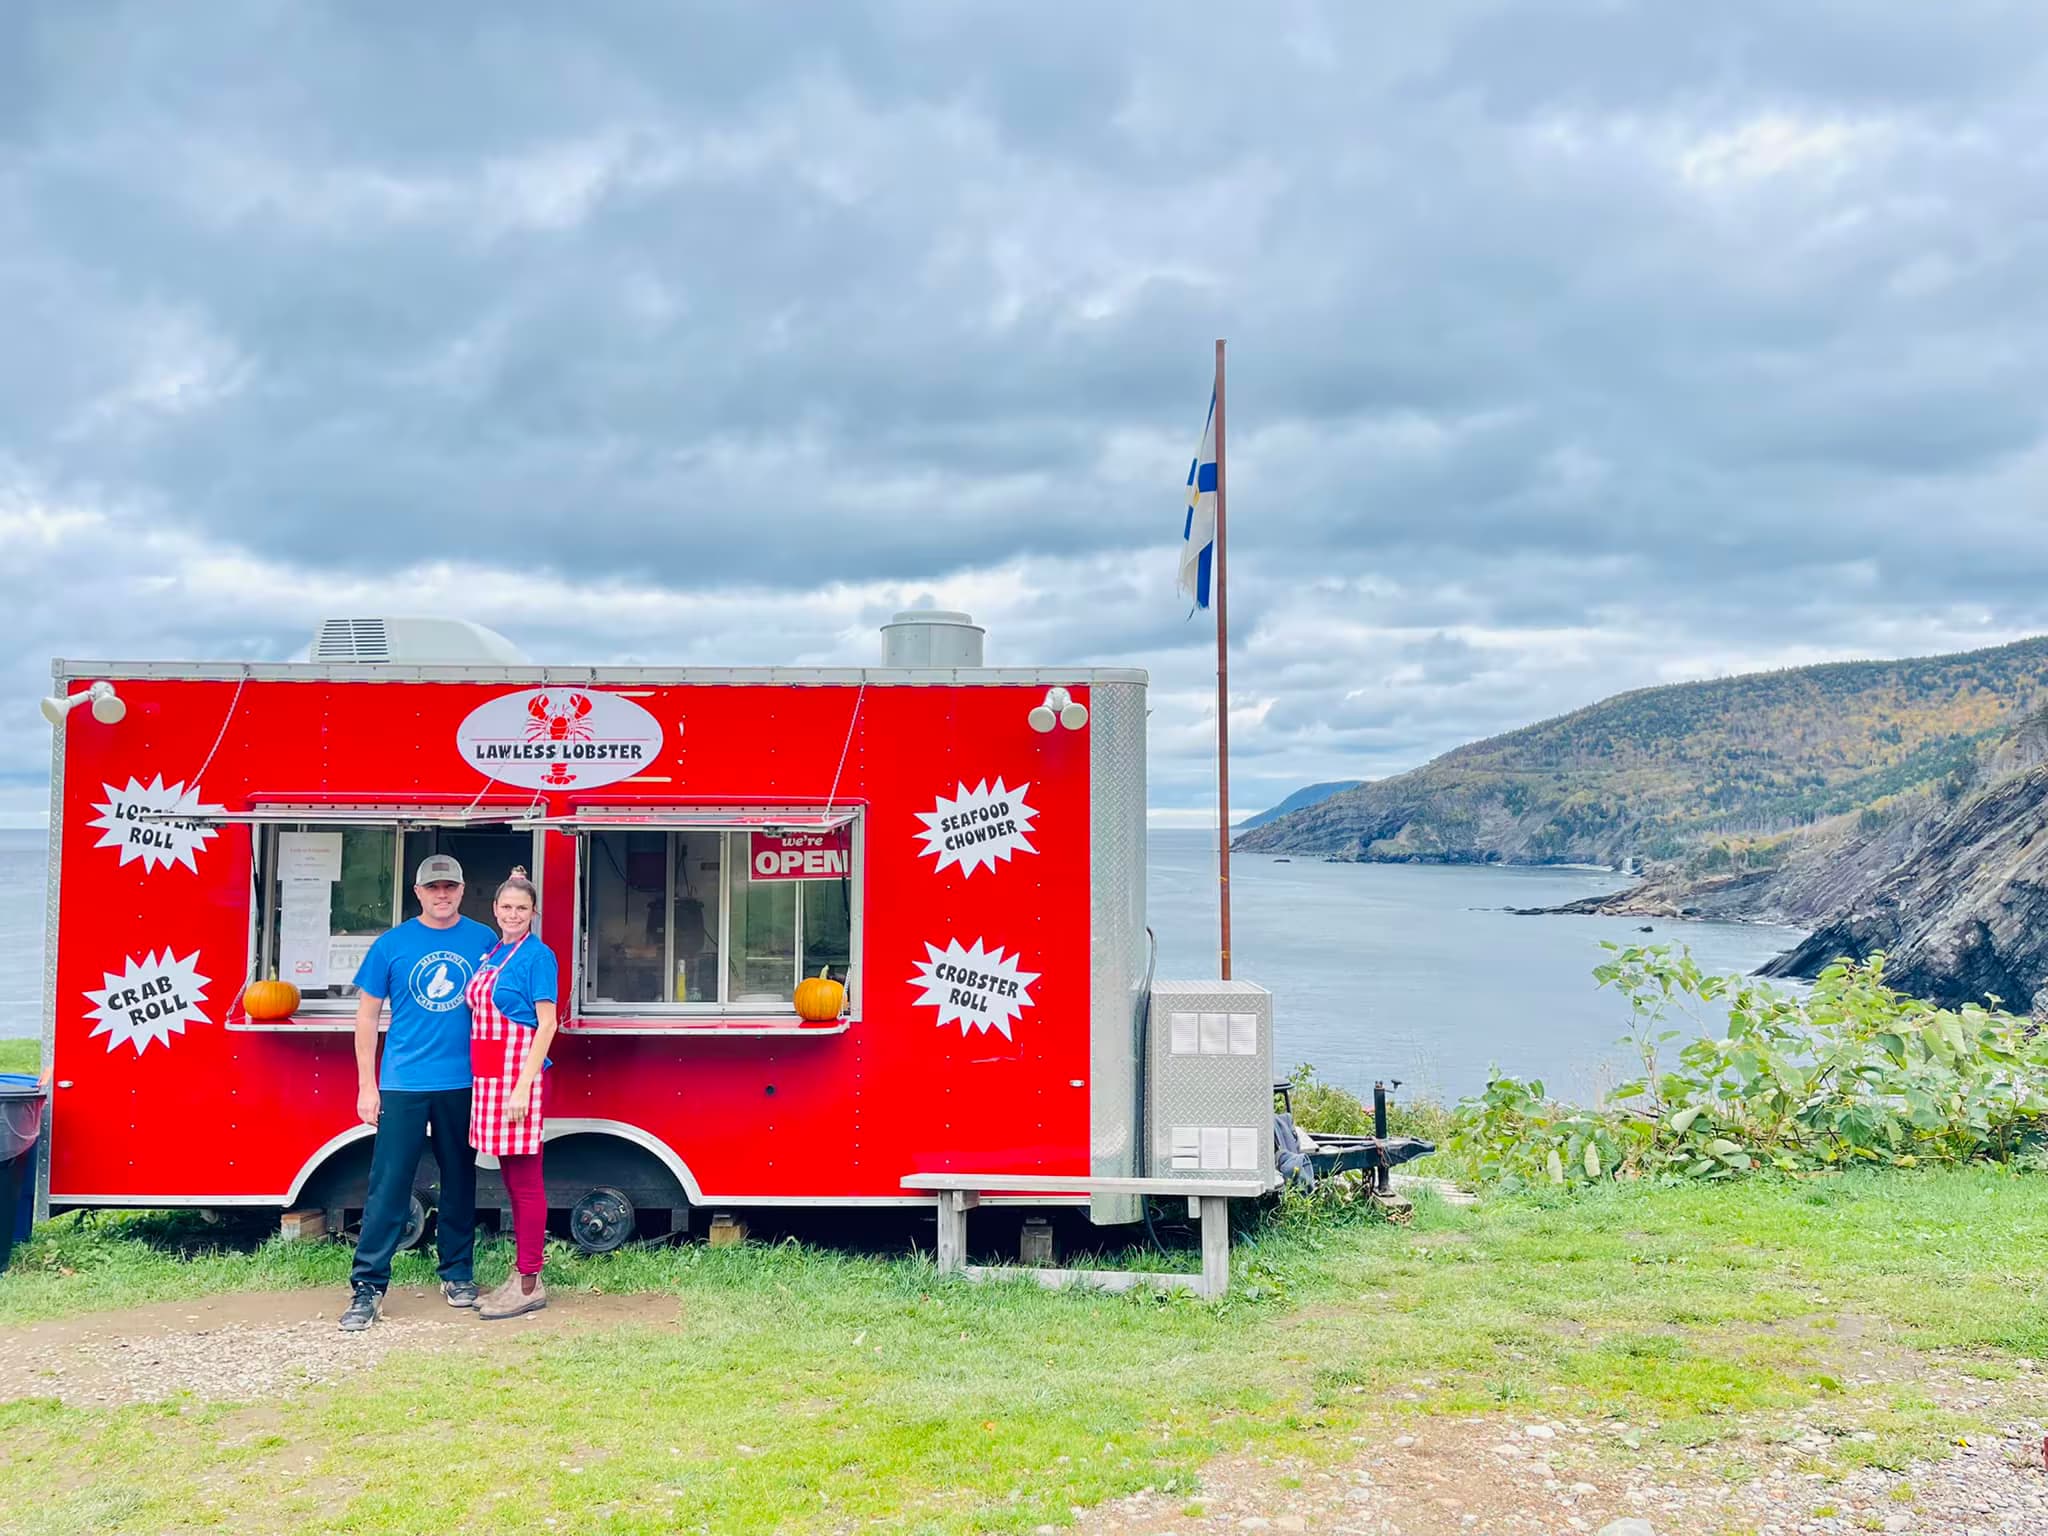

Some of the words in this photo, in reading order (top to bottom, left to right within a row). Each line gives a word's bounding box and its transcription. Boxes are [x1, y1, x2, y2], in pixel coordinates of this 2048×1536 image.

[476, 744, 557, 760] LAWLESS
[562, 744, 643, 760] LOBSTER
[940, 801, 1010, 833] SEAFOOD
[129, 826, 174, 850] ROLL
[781, 834, 824, 847] we're
[945, 819, 1018, 851] CHOWDER
[755, 849, 849, 875] OPEN
[107, 975, 173, 1011] CRAB
[935, 962, 1019, 998] CROBSTER
[128, 993, 189, 1027] ROLL
[948, 987, 988, 1013] ROLL
